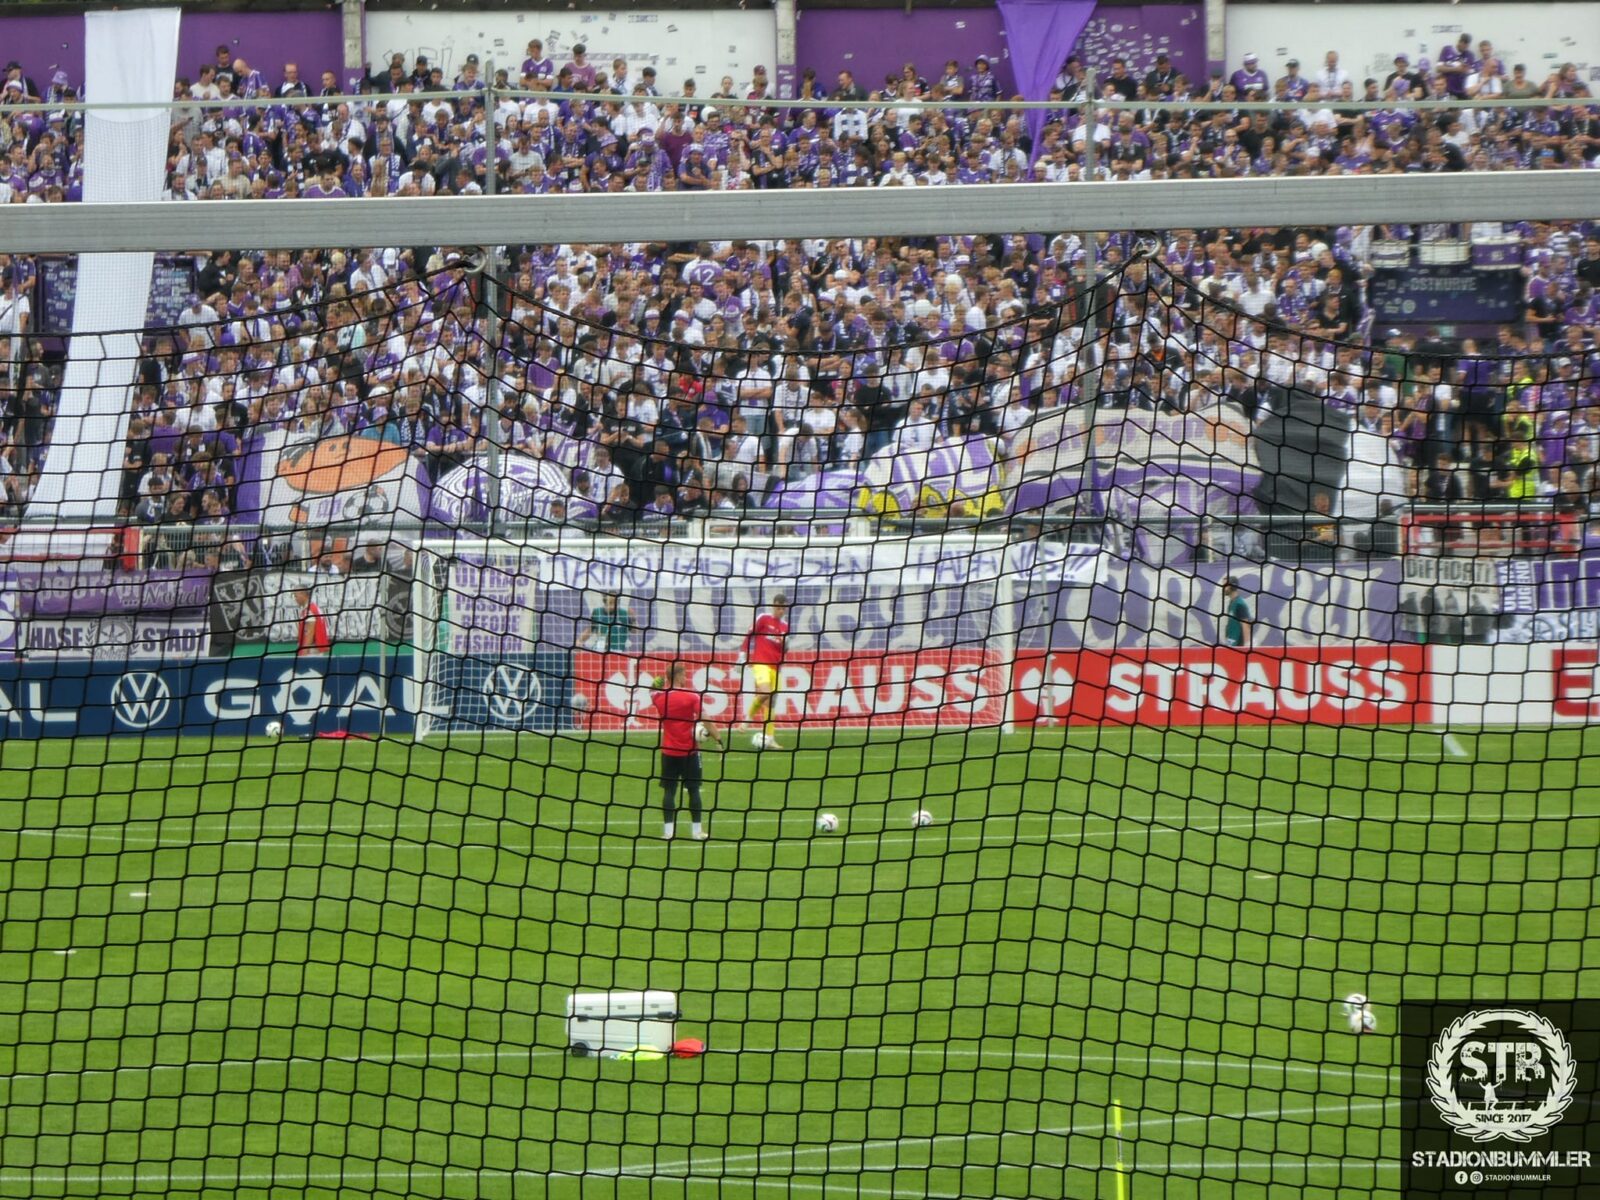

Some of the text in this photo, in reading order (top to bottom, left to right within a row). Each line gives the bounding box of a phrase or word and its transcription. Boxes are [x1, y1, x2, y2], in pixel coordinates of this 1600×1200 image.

[694, 268, 715, 286] 12
[455, 566, 529, 588] ULTRAS
[1515, 560, 1533, 611] JUGEND
[456, 593, 525, 612] PASSION
[31, 626, 209, 652] HASE STADT
[455, 635, 521, 652] FASHION
[1106, 659, 1408, 713] STRAUSS
